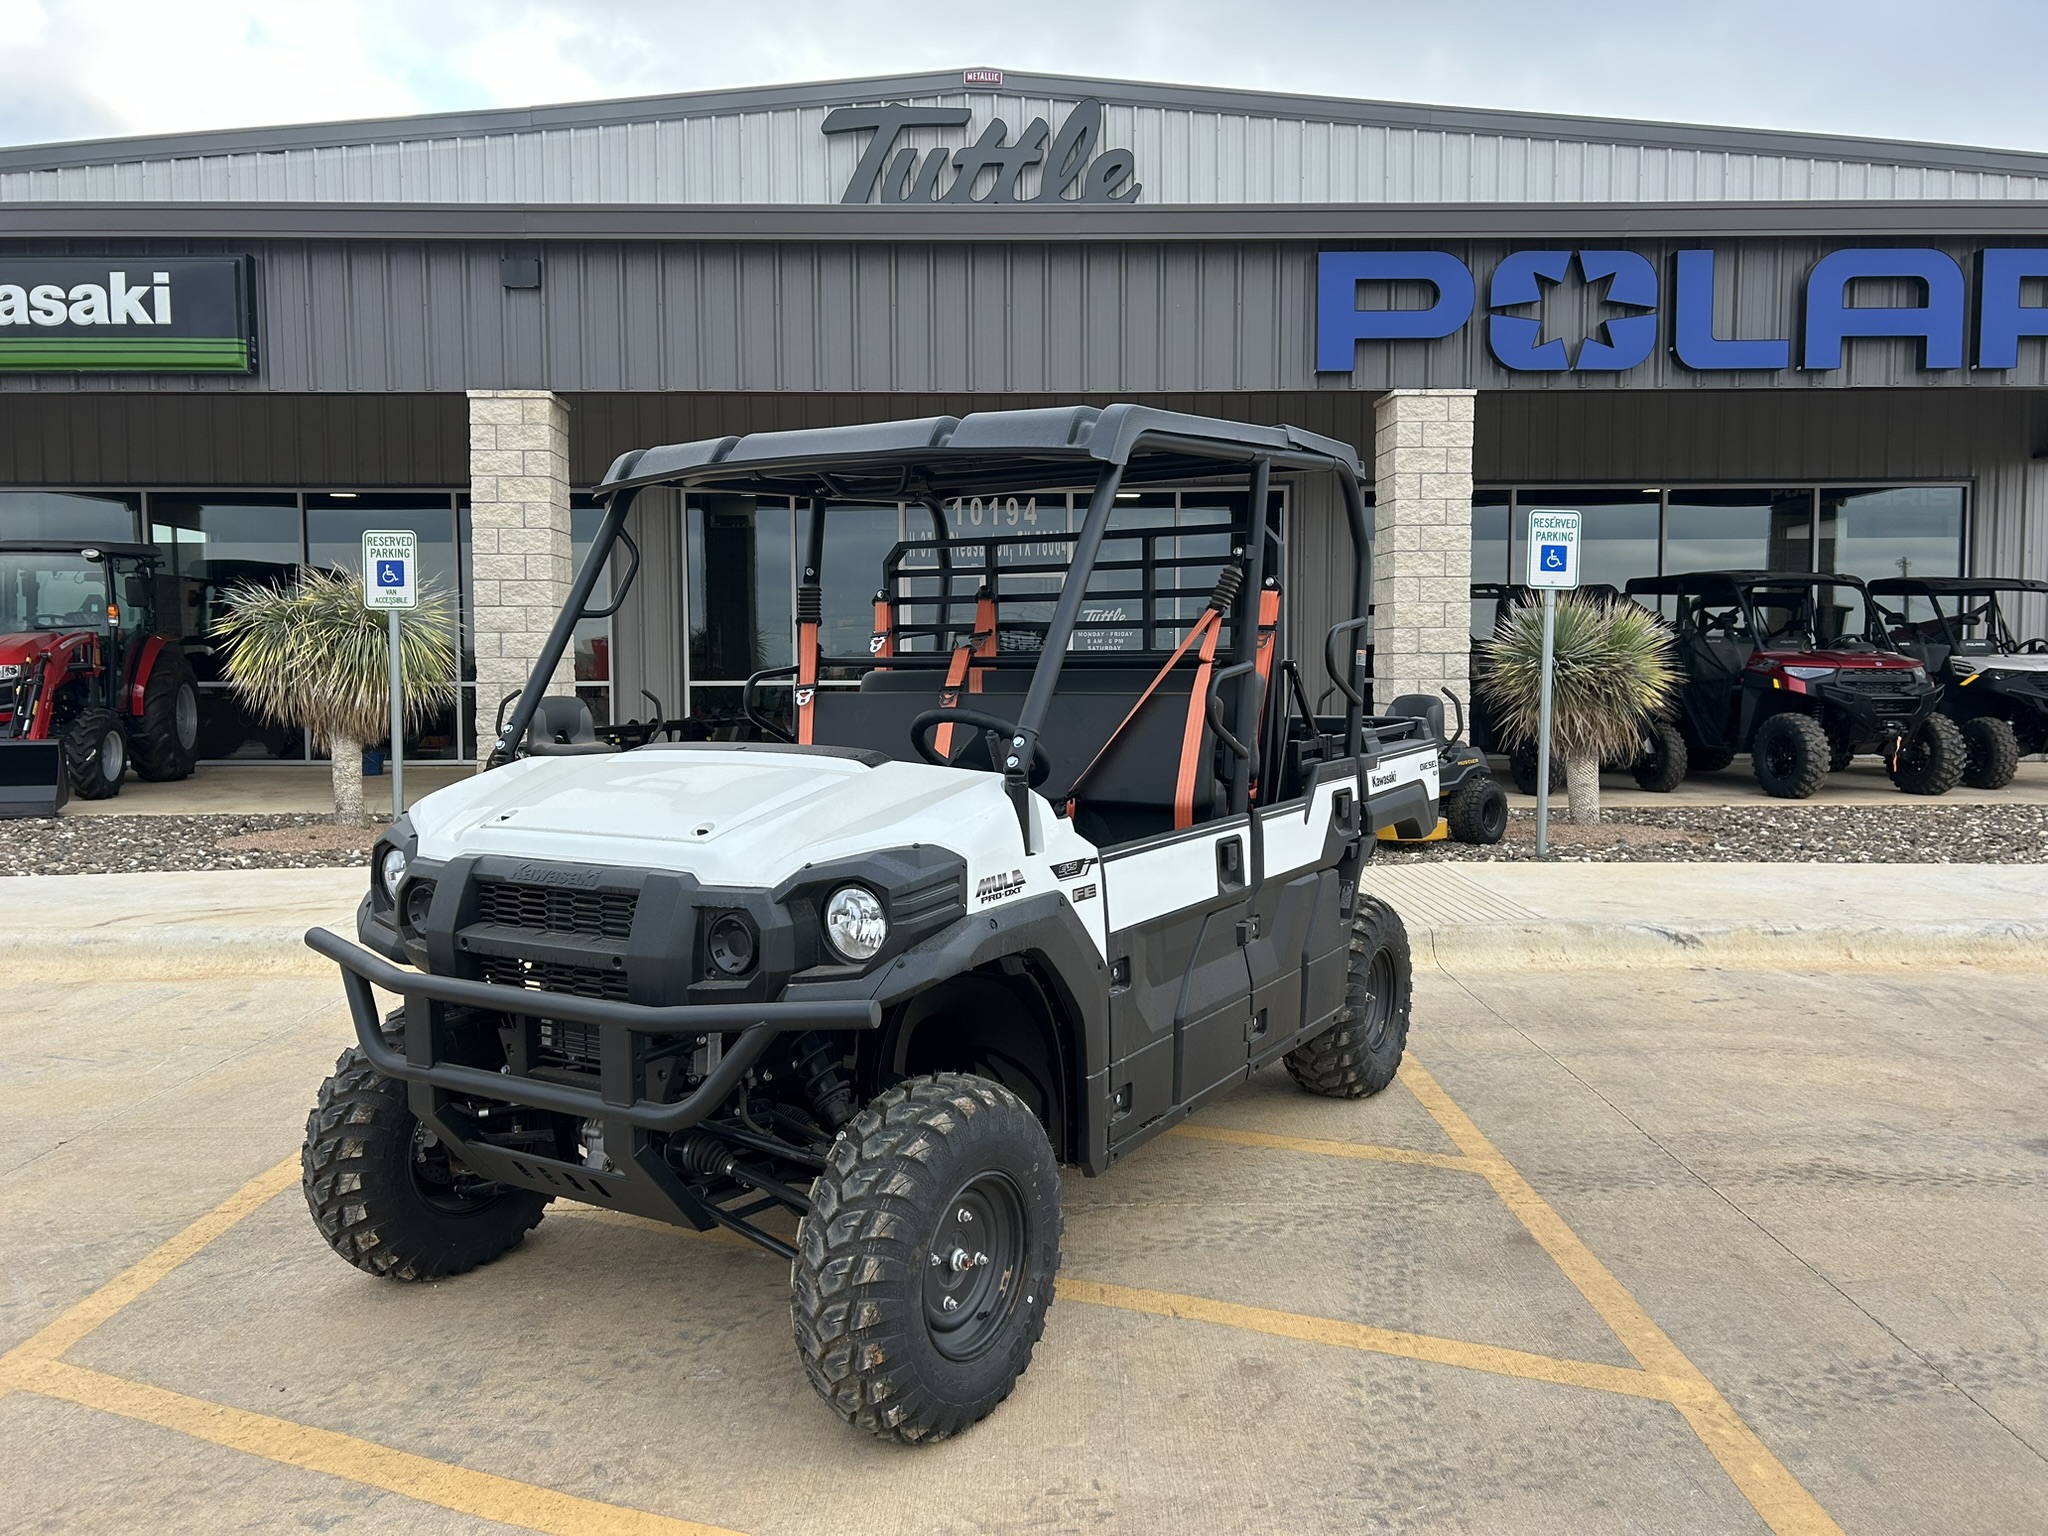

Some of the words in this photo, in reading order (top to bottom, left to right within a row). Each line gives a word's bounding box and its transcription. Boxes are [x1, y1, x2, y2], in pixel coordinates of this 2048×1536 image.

[967, 71, 999, 81] METALLIC
[821, 98, 1142, 204] Tuttle
[953, 497, 1037, 525] 10194
[1533, 518, 1577, 529] RESERVED
[367, 536, 413, 547] RESERVED
[1536, 531, 1574, 542] PARKING
[370, 548, 410, 558] PARKING
[1420, 760, 1437, 771] DIESEL
[1372, 770, 1397, 788] Kawasaki
[509, 863, 603, 888] Kawasaki
[975, 869, 1026, 898] MULE
[981, 886, 1022, 904] PRO-DXT
[1073, 885, 1096, 901] FE
